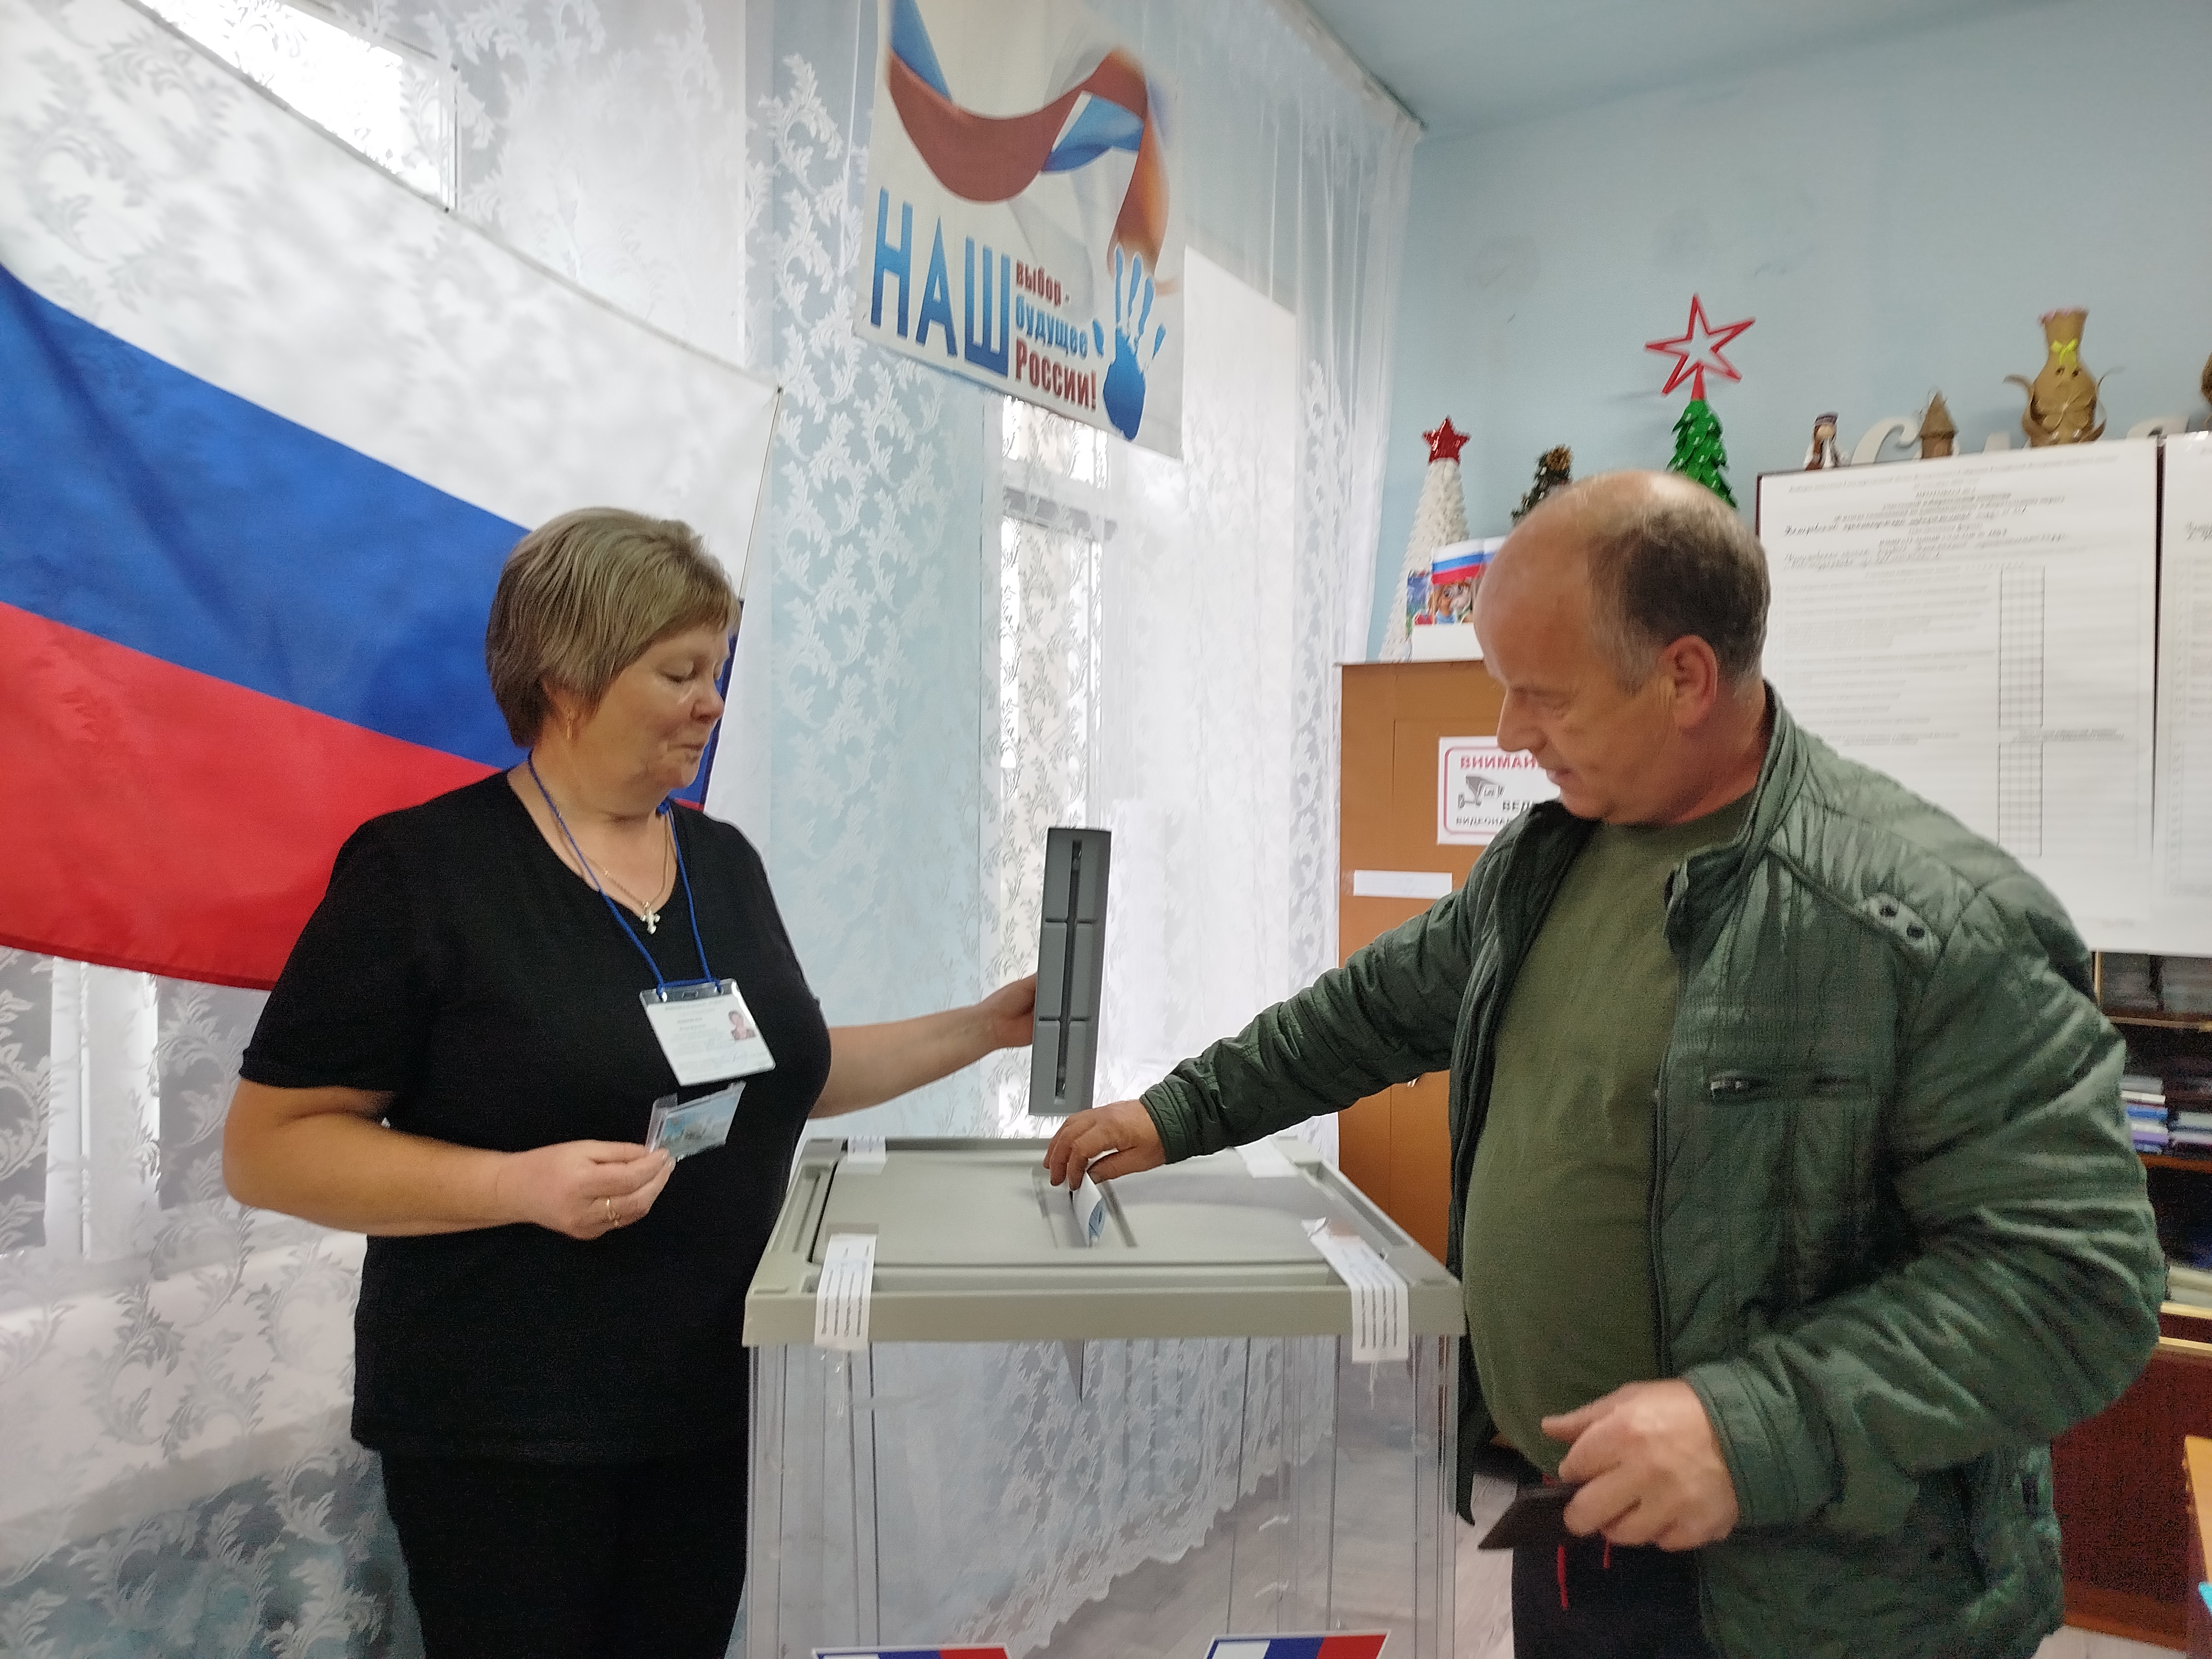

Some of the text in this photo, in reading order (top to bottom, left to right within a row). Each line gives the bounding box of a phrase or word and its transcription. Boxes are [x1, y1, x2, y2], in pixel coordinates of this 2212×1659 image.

[870, 186, 1010, 379] НАШ
[1016, 294, 1088, 359] будущее
[1460, 755, 1537, 769] ВНИМАН
